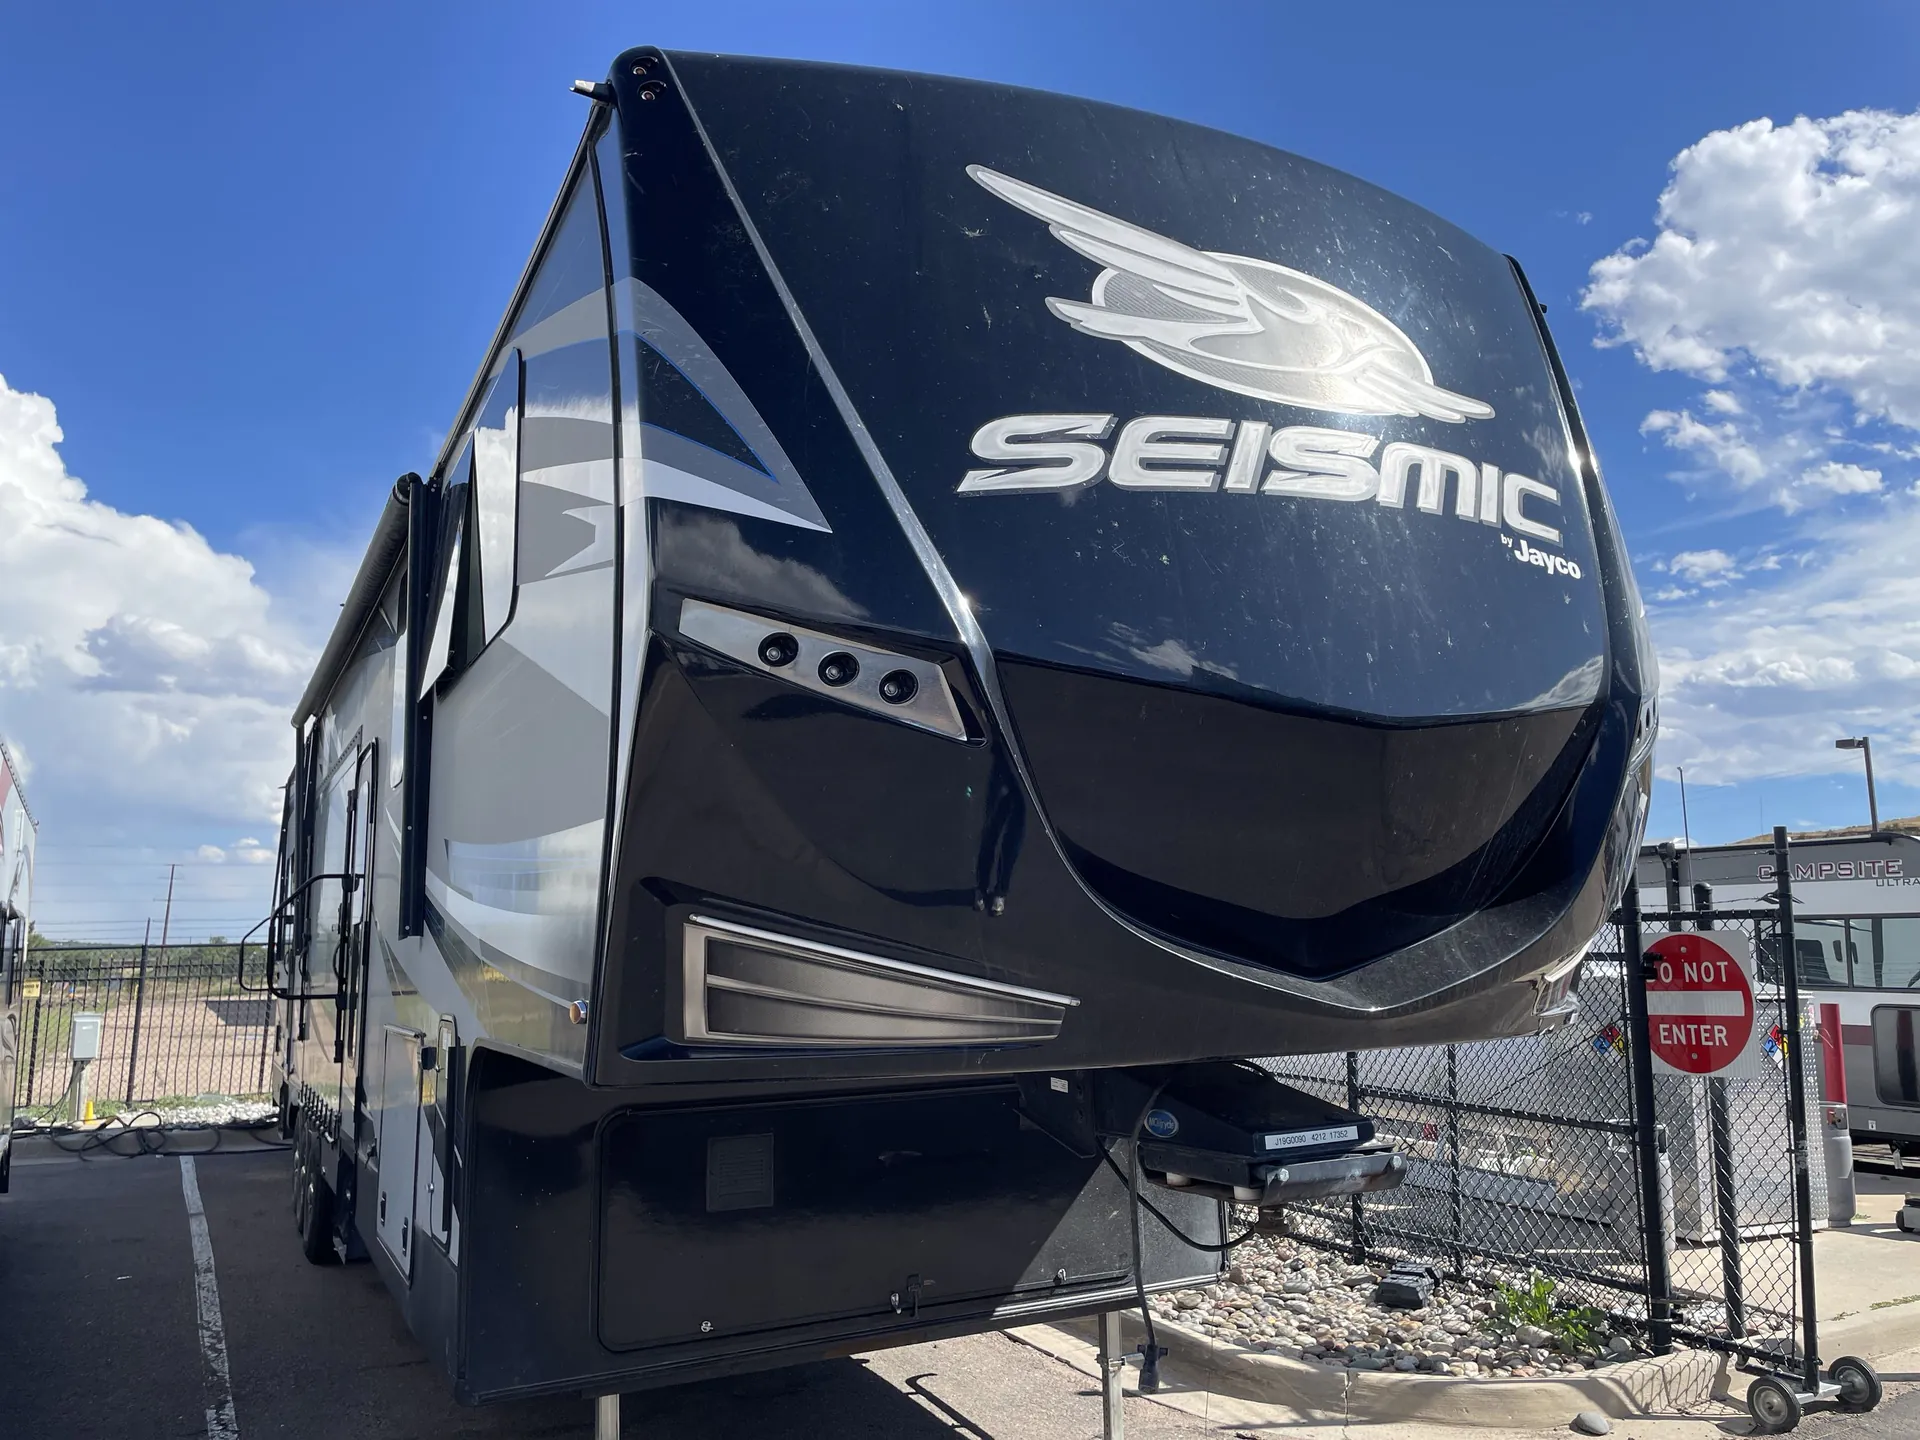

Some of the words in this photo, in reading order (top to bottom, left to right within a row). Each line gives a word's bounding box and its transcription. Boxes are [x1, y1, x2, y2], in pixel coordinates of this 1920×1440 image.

[956, 413, 1562, 543] SEISMIC
[1500, 533, 1513, 548] by
[1514, 539, 1582, 580] Jayco
[1757, 859, 1904, 882] CMPSITE
[1876, 877, 1920, 887] ULTRA
[1646, 962, 1673, 983] O
[1683, 961, 1728, 983] NOT
[1659, 1024, 1728, 1047] ENTER
[1311, 1132, 1327, 1142] 4212
[1329, 1129, 1349, 1140] 17352
